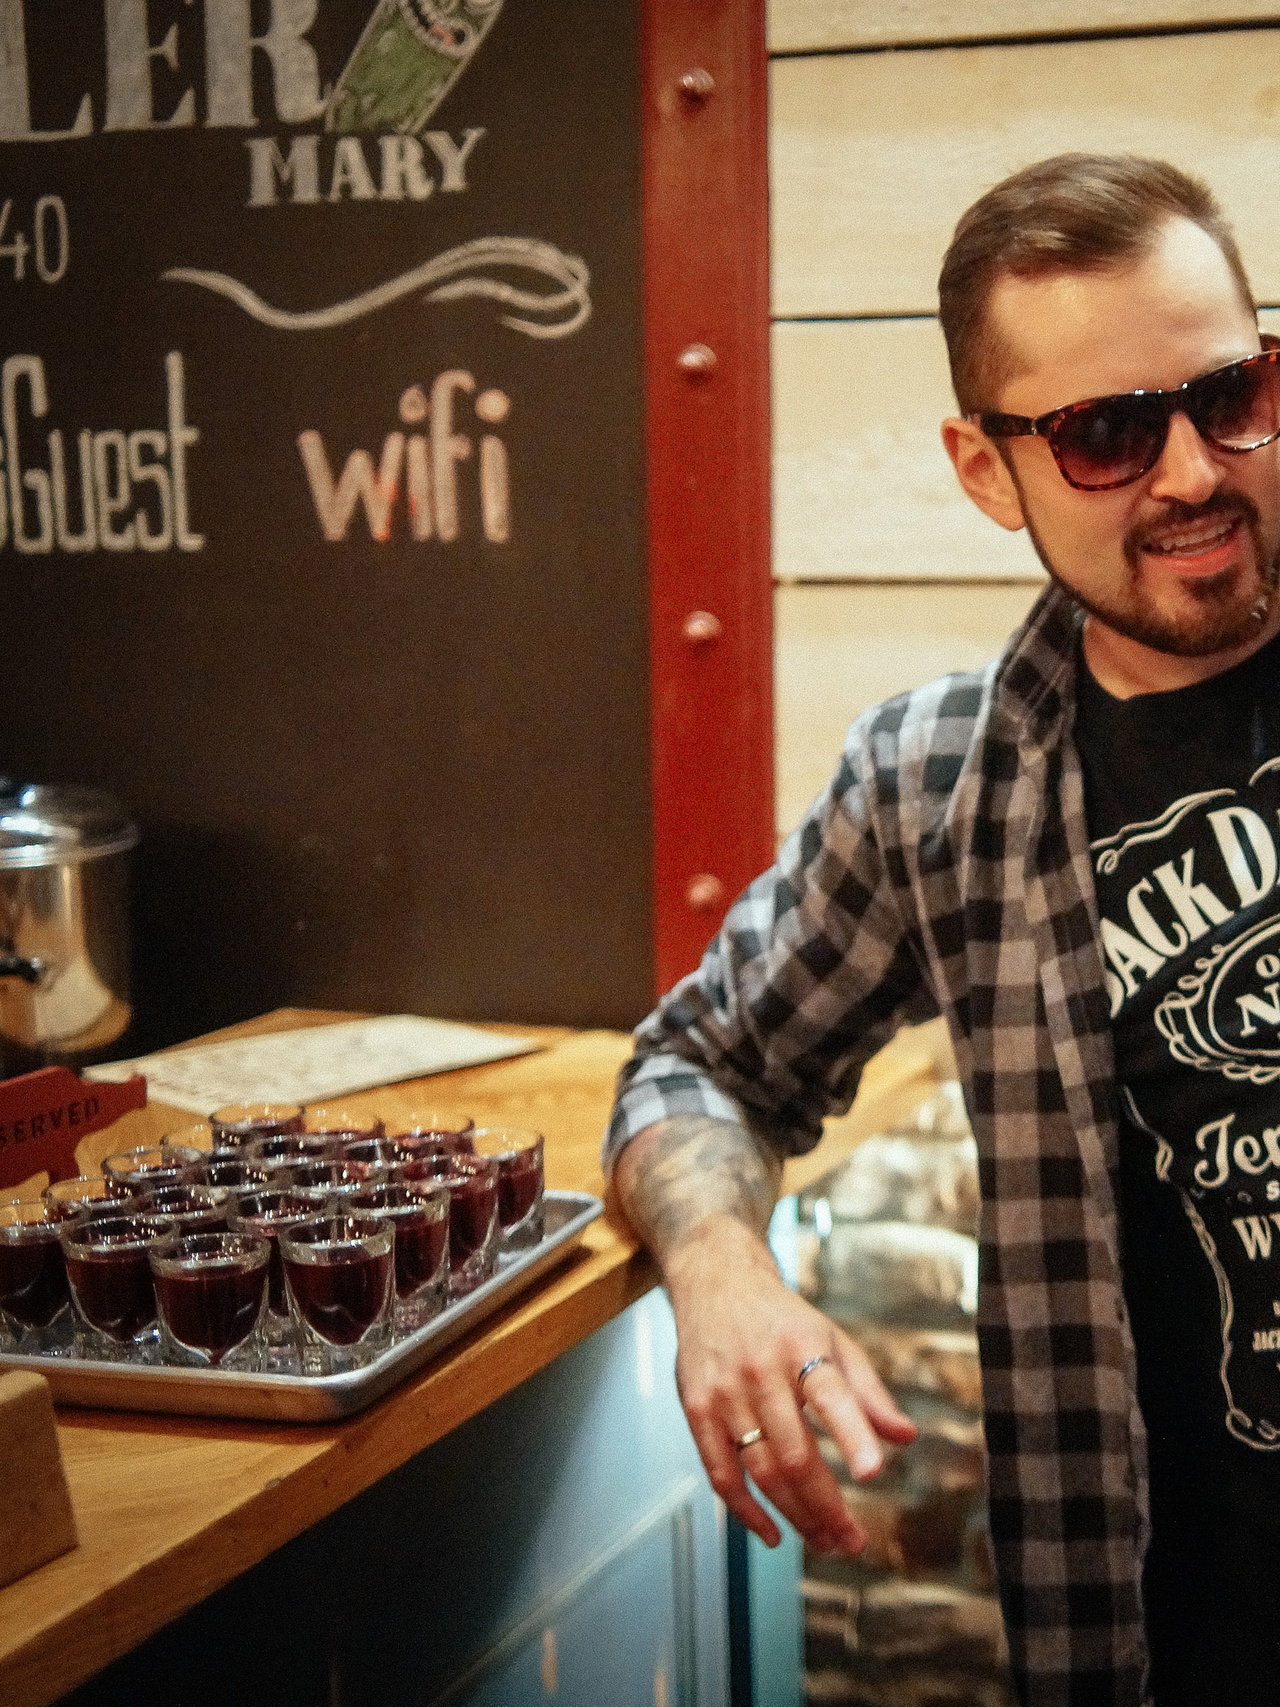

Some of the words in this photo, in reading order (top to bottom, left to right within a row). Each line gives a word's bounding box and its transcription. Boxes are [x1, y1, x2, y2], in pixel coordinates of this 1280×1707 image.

[245, 128, 486, 206] MARY
[0, 351, 205, 553] Guest
[299, 369, 511, 542] wifi
